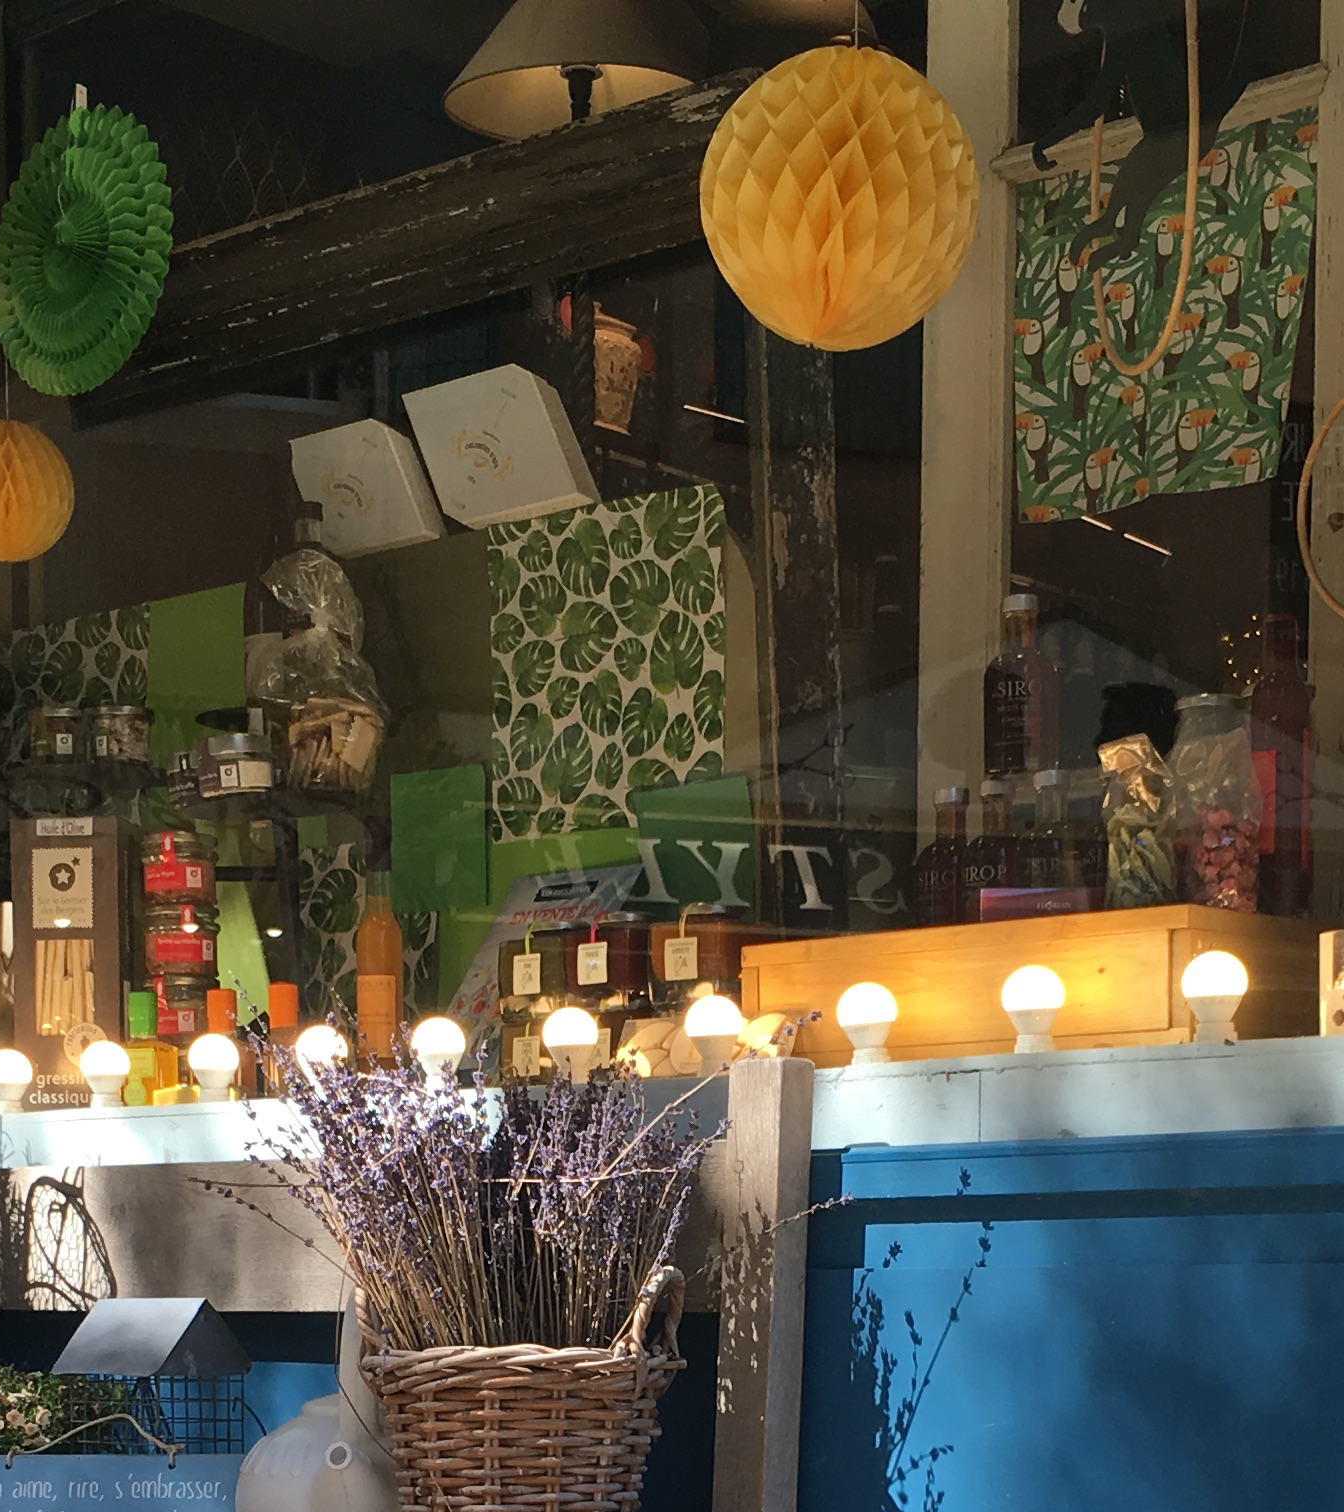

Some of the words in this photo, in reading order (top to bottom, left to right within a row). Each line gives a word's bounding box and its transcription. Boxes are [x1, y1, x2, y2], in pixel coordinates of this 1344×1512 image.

[29, 1090, 91, 1107] classiqu
[12, 1481, 57, 1501] aime,
[69, 1479, 104, 1501] rire,
[115, 1473, 227, 1501] s'embrasser,
